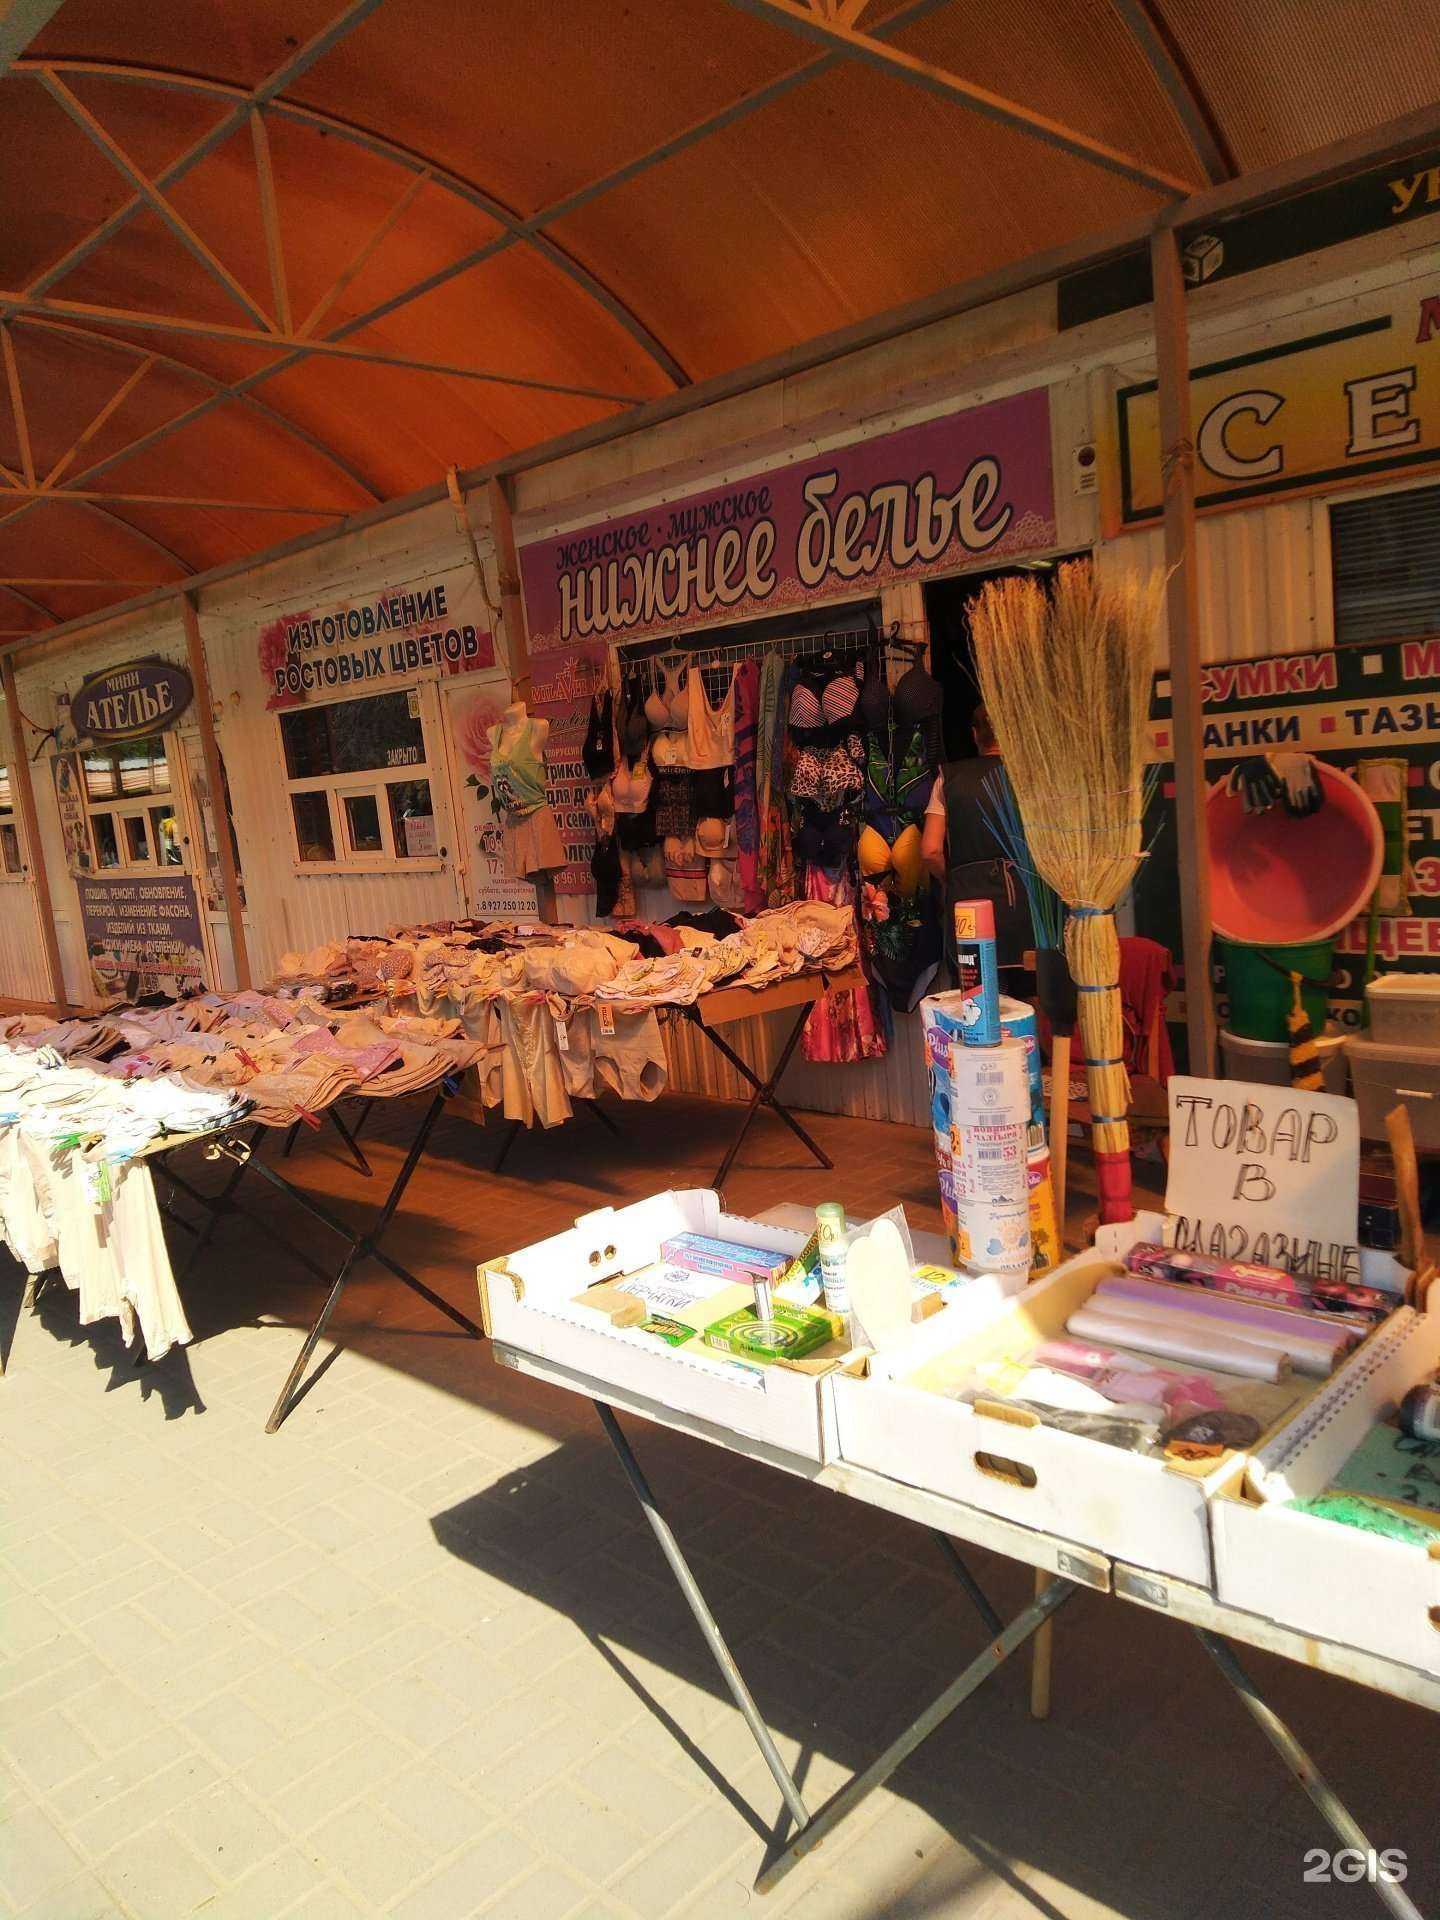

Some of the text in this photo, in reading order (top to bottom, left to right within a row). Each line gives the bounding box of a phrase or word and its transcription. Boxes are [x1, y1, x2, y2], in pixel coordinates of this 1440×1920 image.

[557, 454, 1012, 642] нижнее белье
[288, 583, 449, 653] ИЗГОТОВЛЕНИЕ
[274, 623, 479, 696] РОСТОВЫХ ЦВЕТОВ
[105, 671, 140, 693] МИНИ
[86, 680, 174, 730] АТЕЛЬЕ
[1203, 715, 1300, 749] АНКИ
[387, 746, 417, 766] ЗАКРЫТО
[158, 904, 193, 919] ФАСОНА,
[1176, 1095, 1338, 1163] ТОВАР
[1232, 1163, 1276, 1202] В
